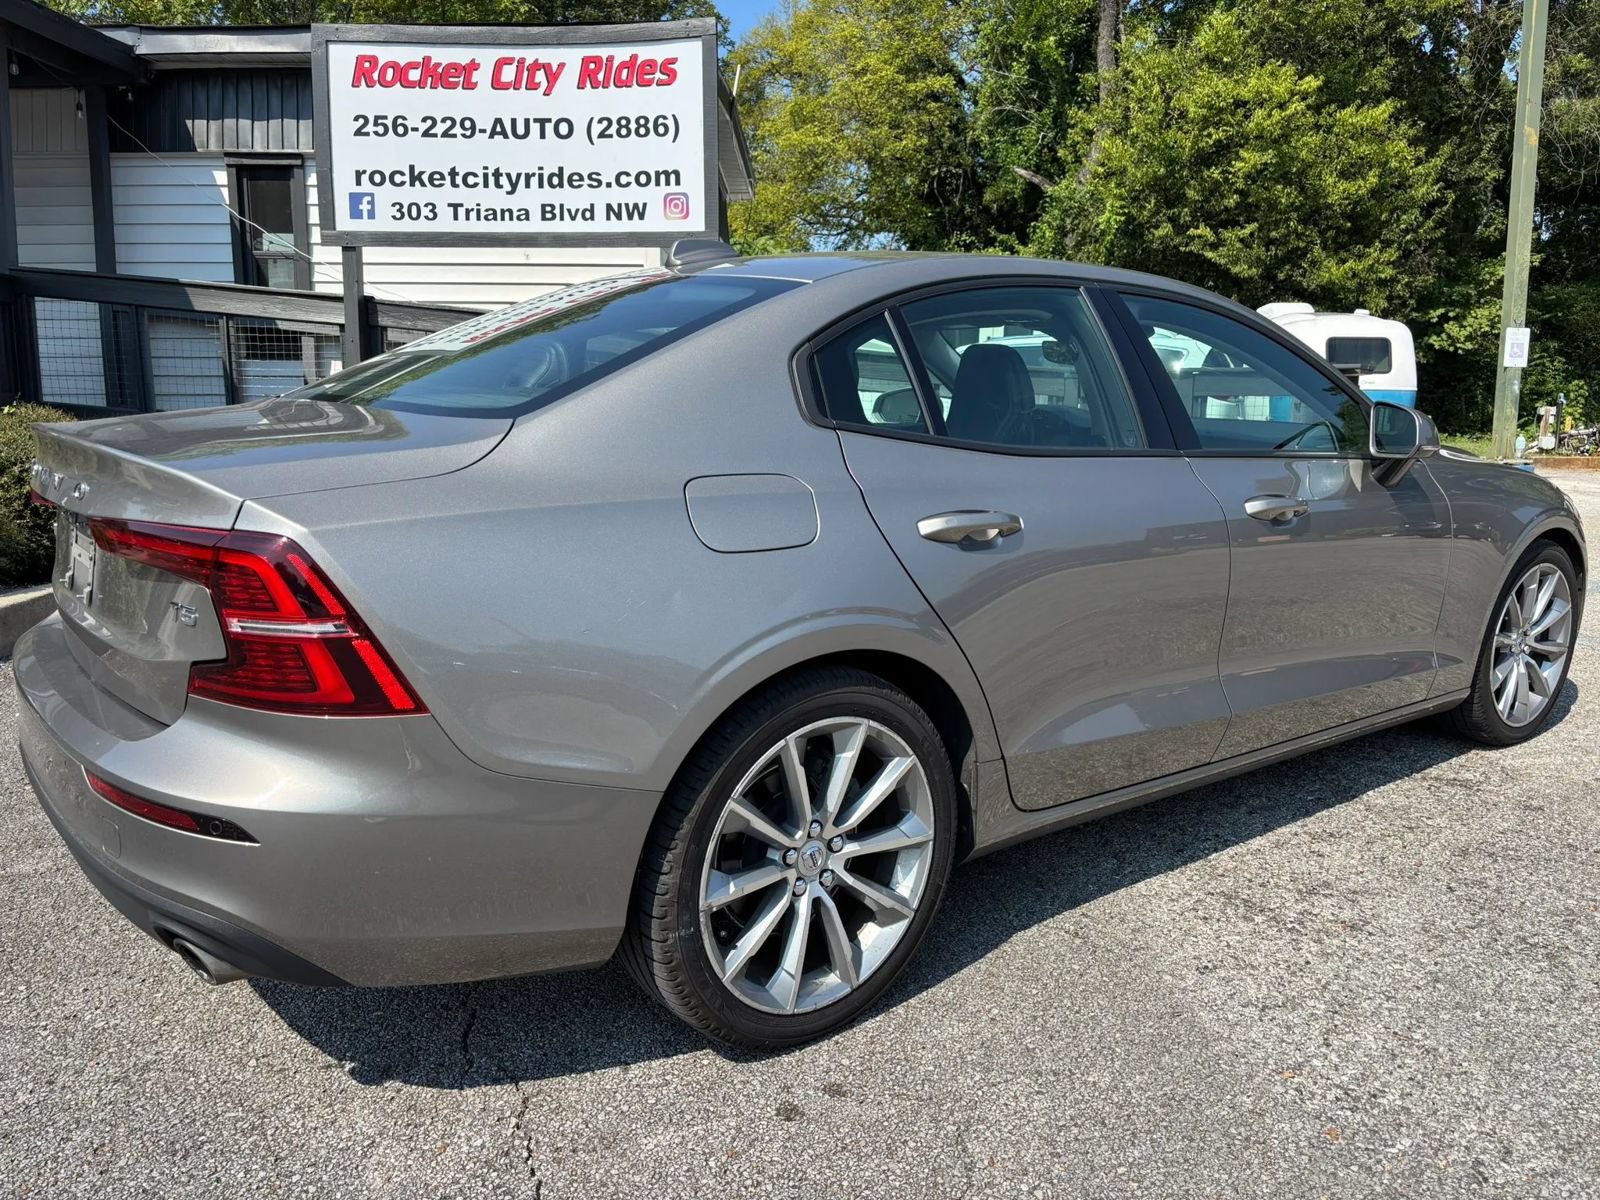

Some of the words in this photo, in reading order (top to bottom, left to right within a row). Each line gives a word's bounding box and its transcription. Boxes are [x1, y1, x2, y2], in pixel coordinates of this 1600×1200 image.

[351, 54, 480, 90] Rocket
[491, 57, 566, 96] City
[577, 53, 679, 90] Rides
[353, 115, 575, 140] 256-229-AUTO
[587, 114, 680, 145] (2886)
[355, 165, 682, 195] rocketcityrides.com
[391, 202, 438, 221] 303
[447, 203, 530, 222] Triana
[541, 203, 595, 222] Blvd
[606, 203, 648, 221] NW
